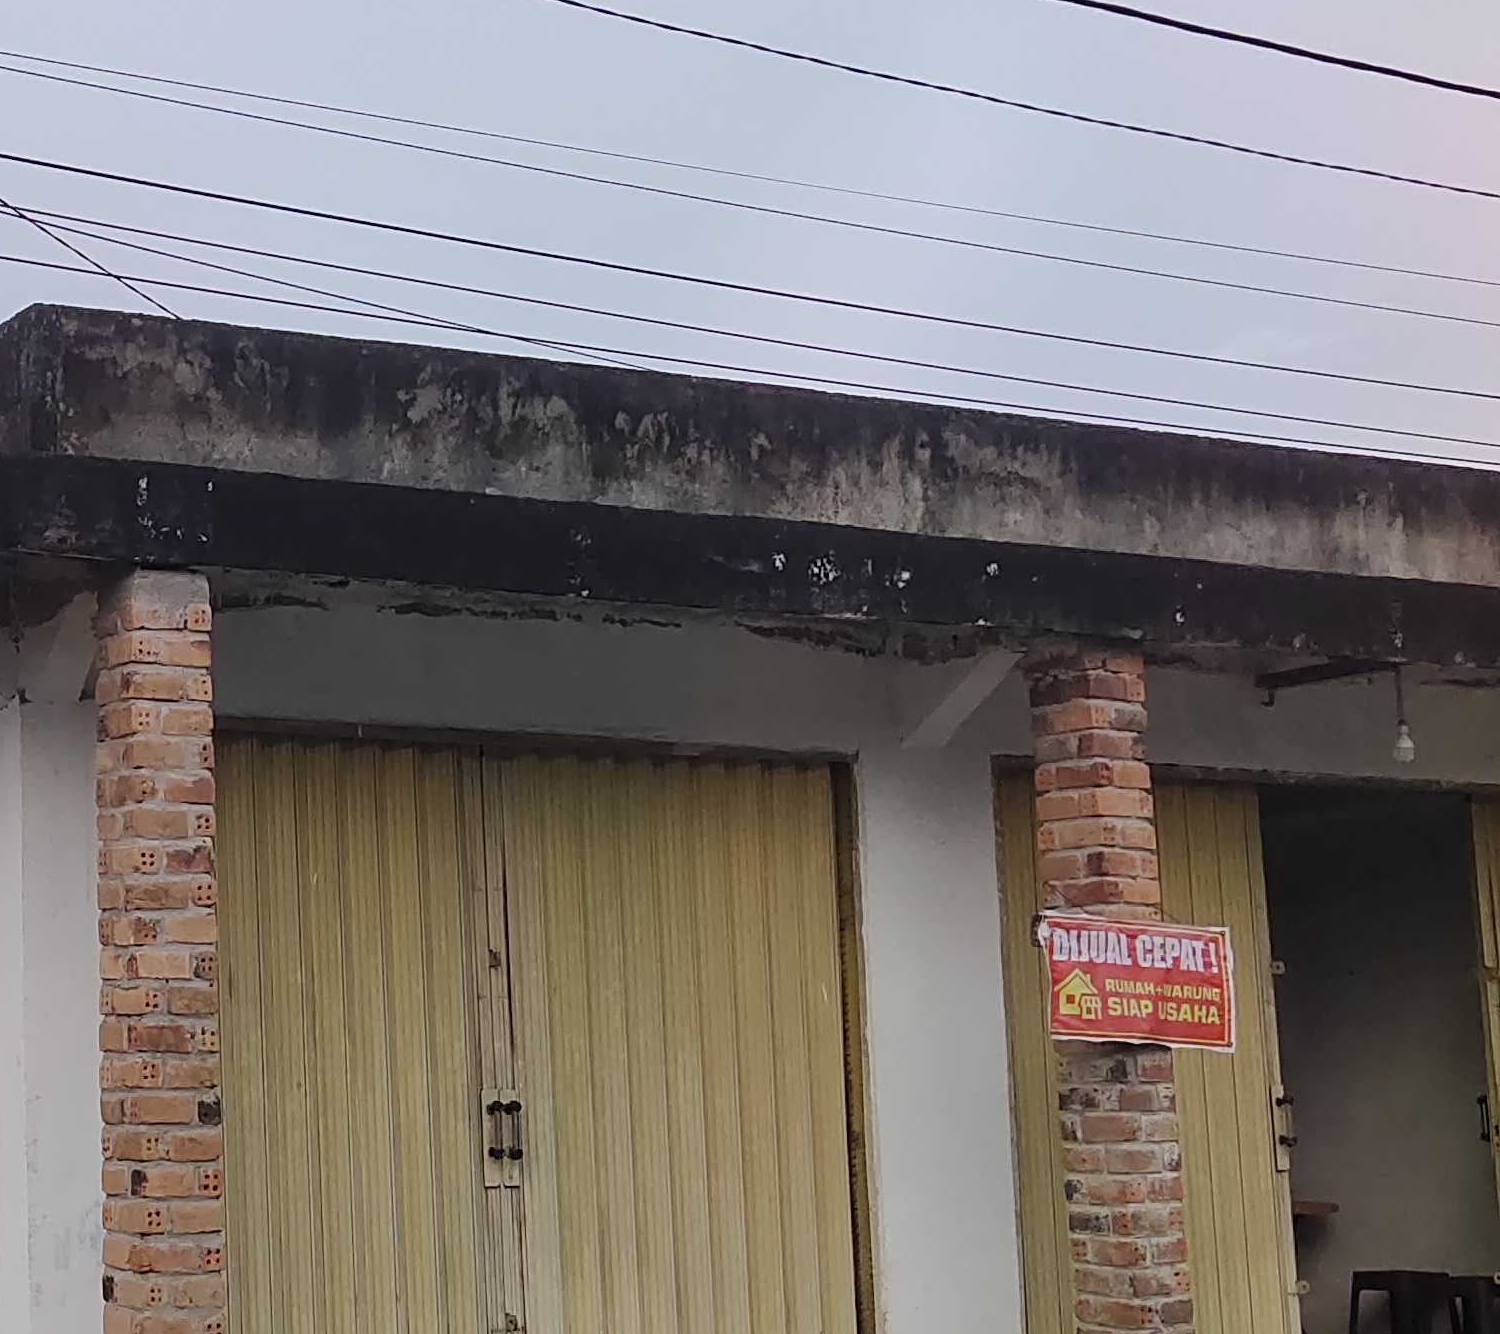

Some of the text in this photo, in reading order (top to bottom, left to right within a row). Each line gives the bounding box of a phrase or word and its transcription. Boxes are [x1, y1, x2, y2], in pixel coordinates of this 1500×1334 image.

[1052, 928, 1132, 965] DIJUAL
[1107, 997, 1220, 1024] SIAP USAHA
